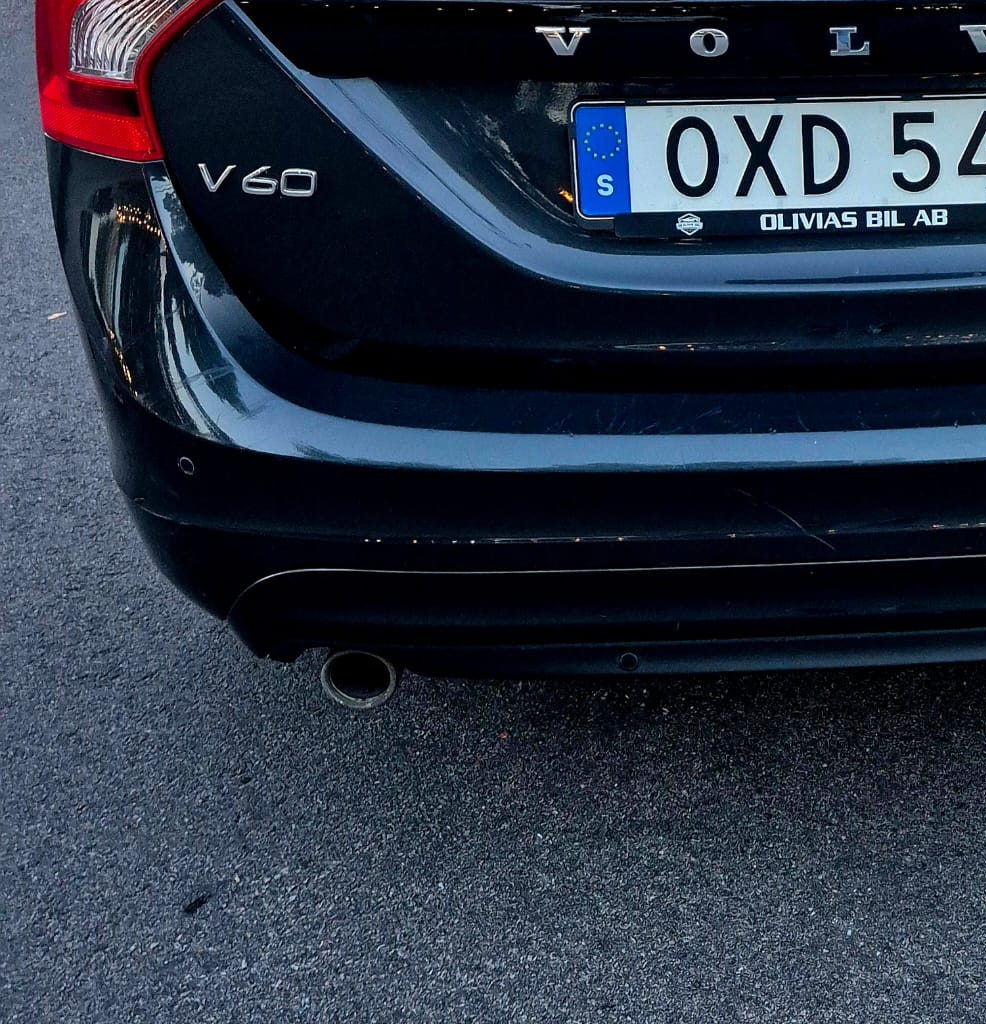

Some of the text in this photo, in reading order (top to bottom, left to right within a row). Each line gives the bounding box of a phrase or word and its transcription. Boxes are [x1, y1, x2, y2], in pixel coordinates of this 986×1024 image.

[665, 113, 851, 198] OXD
[197, 163, 318, 197] V60
[596, 174, 614, 197] S
[759, 208, 949, 231] OLIVIAS BIL AB
